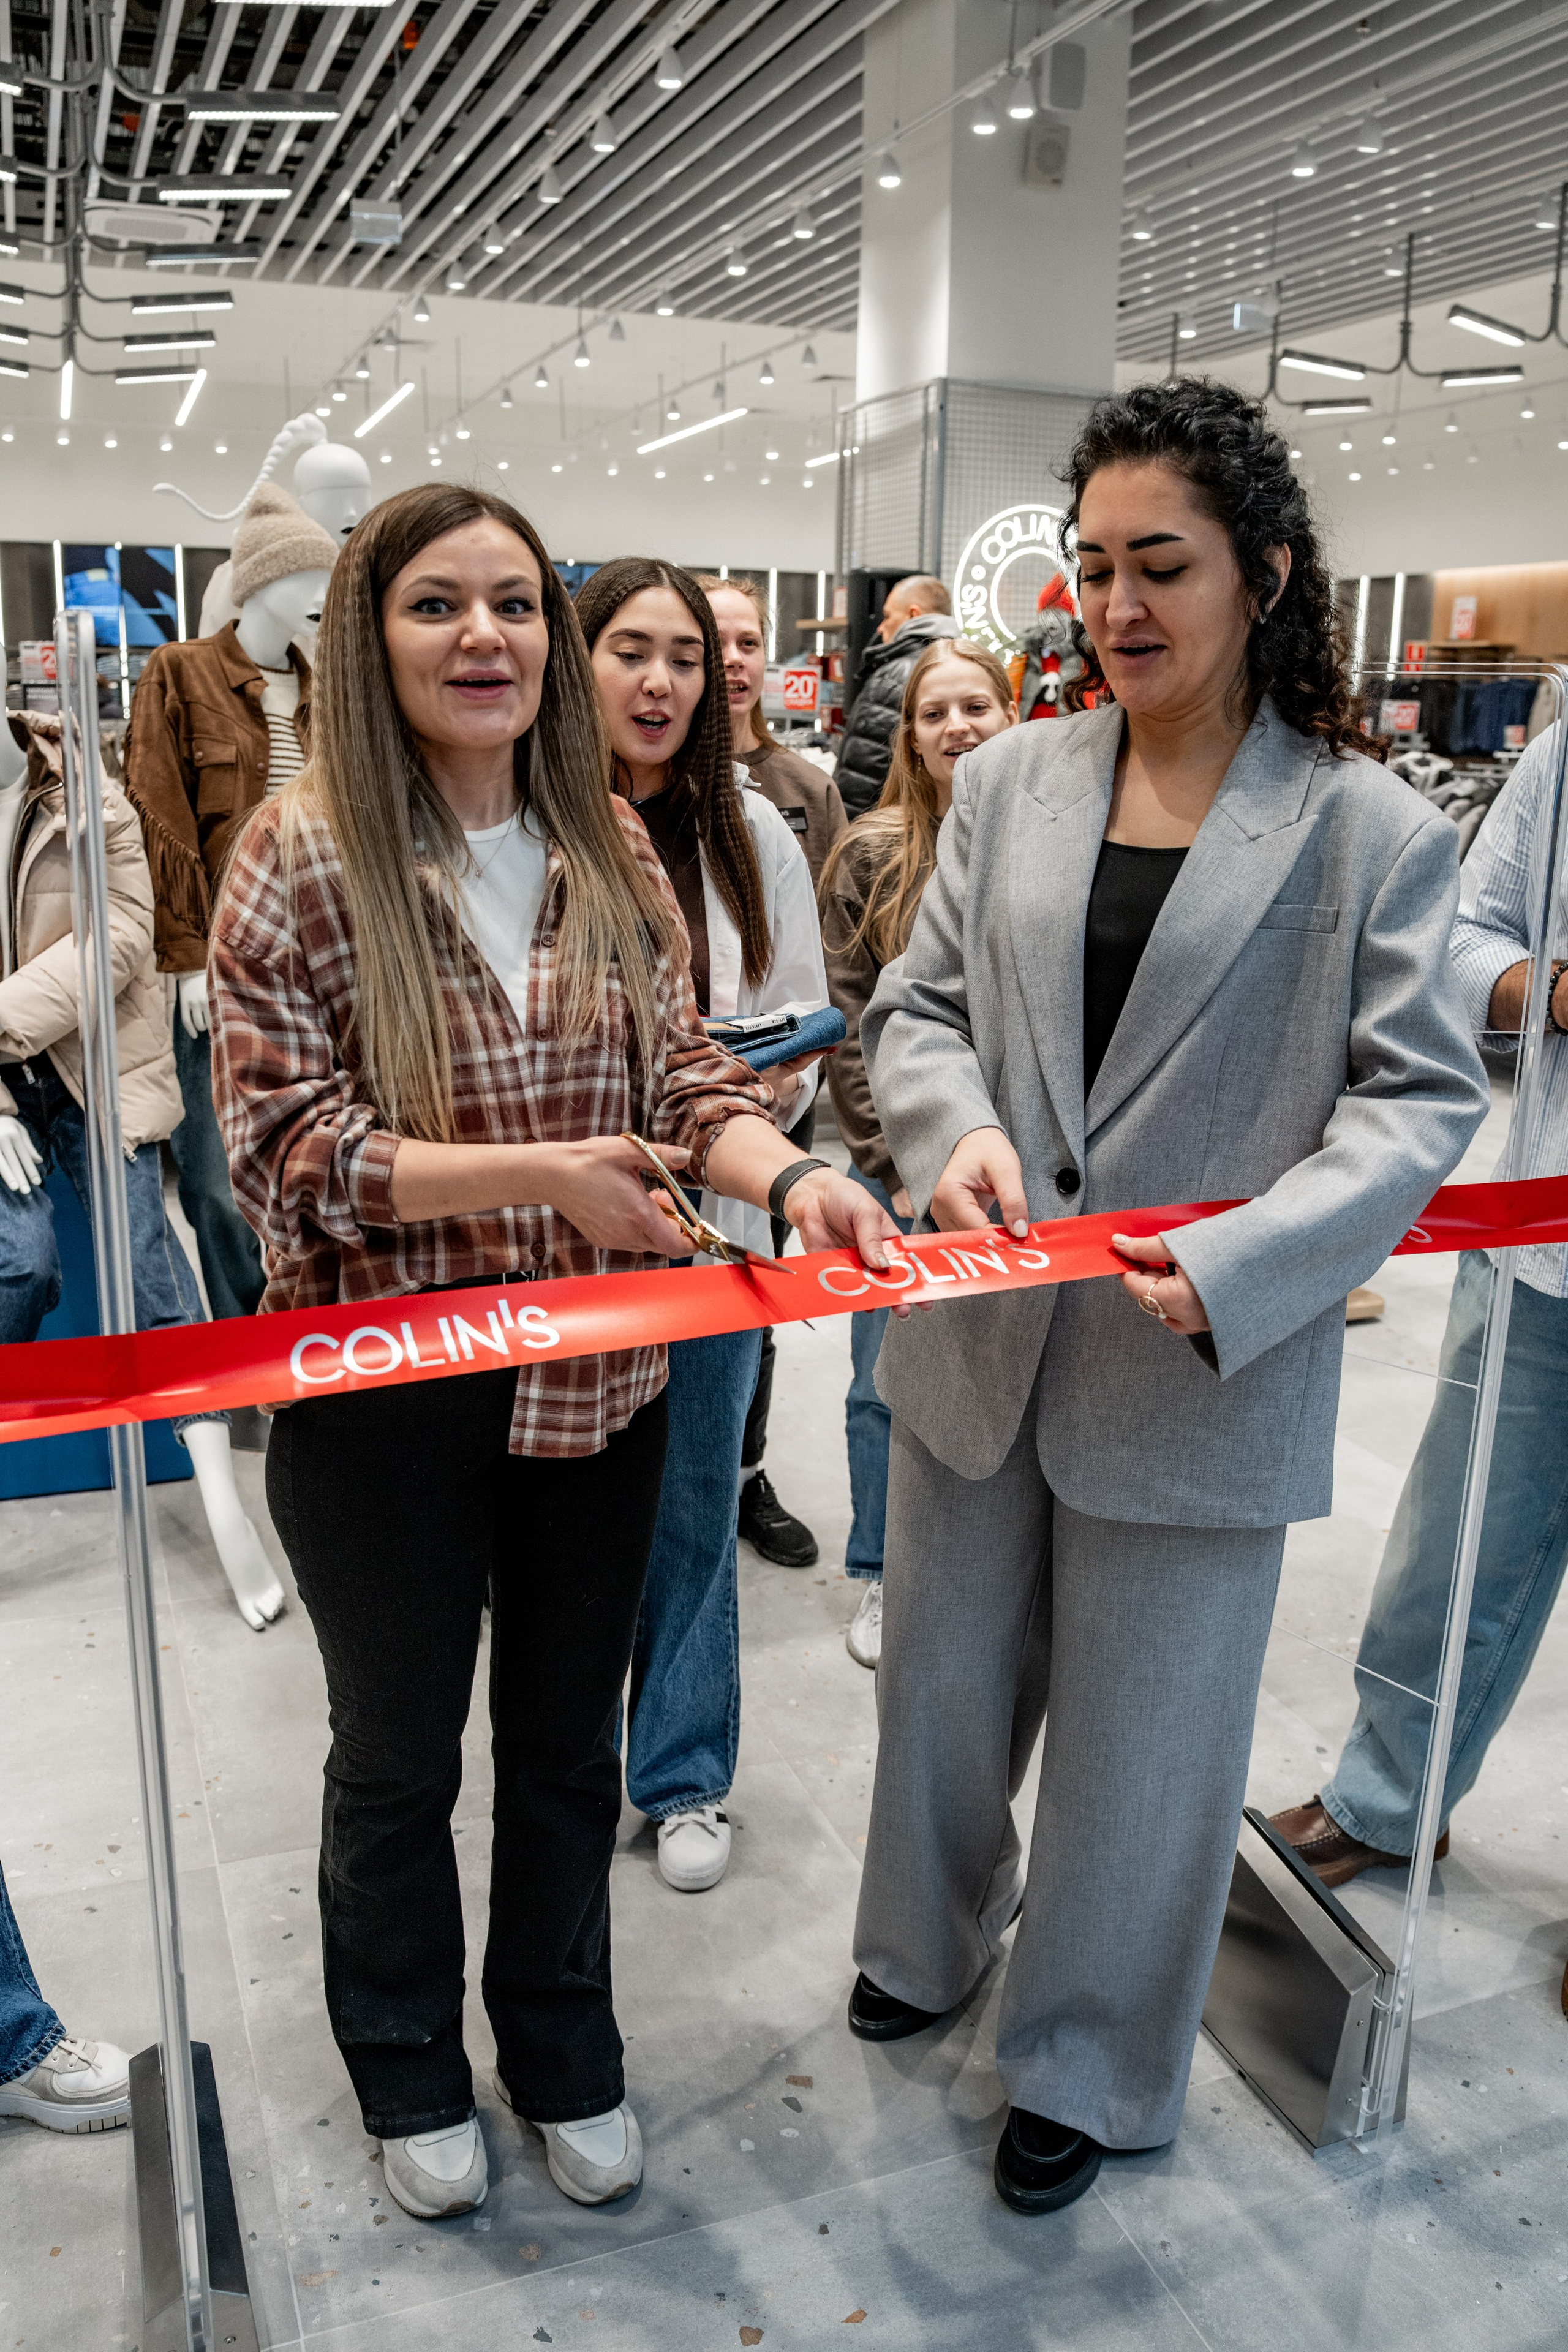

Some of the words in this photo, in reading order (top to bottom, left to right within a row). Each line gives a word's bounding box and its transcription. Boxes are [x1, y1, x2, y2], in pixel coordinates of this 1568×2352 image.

[981, 513, 1069, 564] COLIN
[818, 1238, 1050, 1297] COLIN'S
[290, 1299, 560, 1384] COLIN'S
